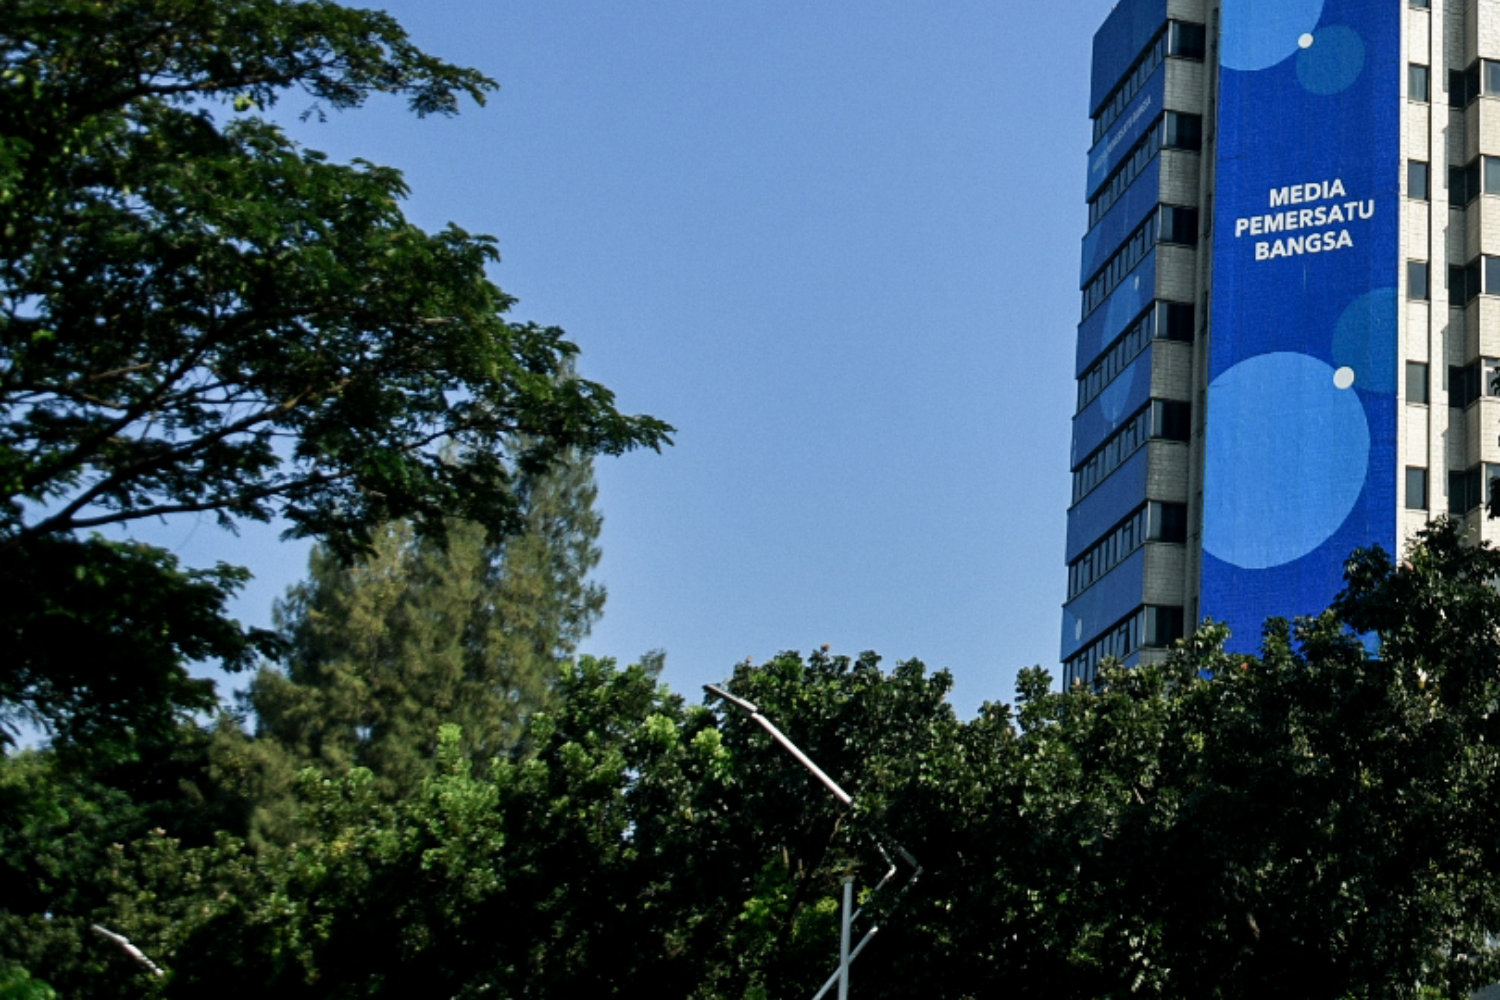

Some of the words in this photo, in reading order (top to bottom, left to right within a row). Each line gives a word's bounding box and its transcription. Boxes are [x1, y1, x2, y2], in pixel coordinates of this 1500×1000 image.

[1269, 178, 1346, 208] MEDIA
[1234, 199, 1375, 237] PEMERSATU
[1255, 229, 1353, 261] BANGSA
